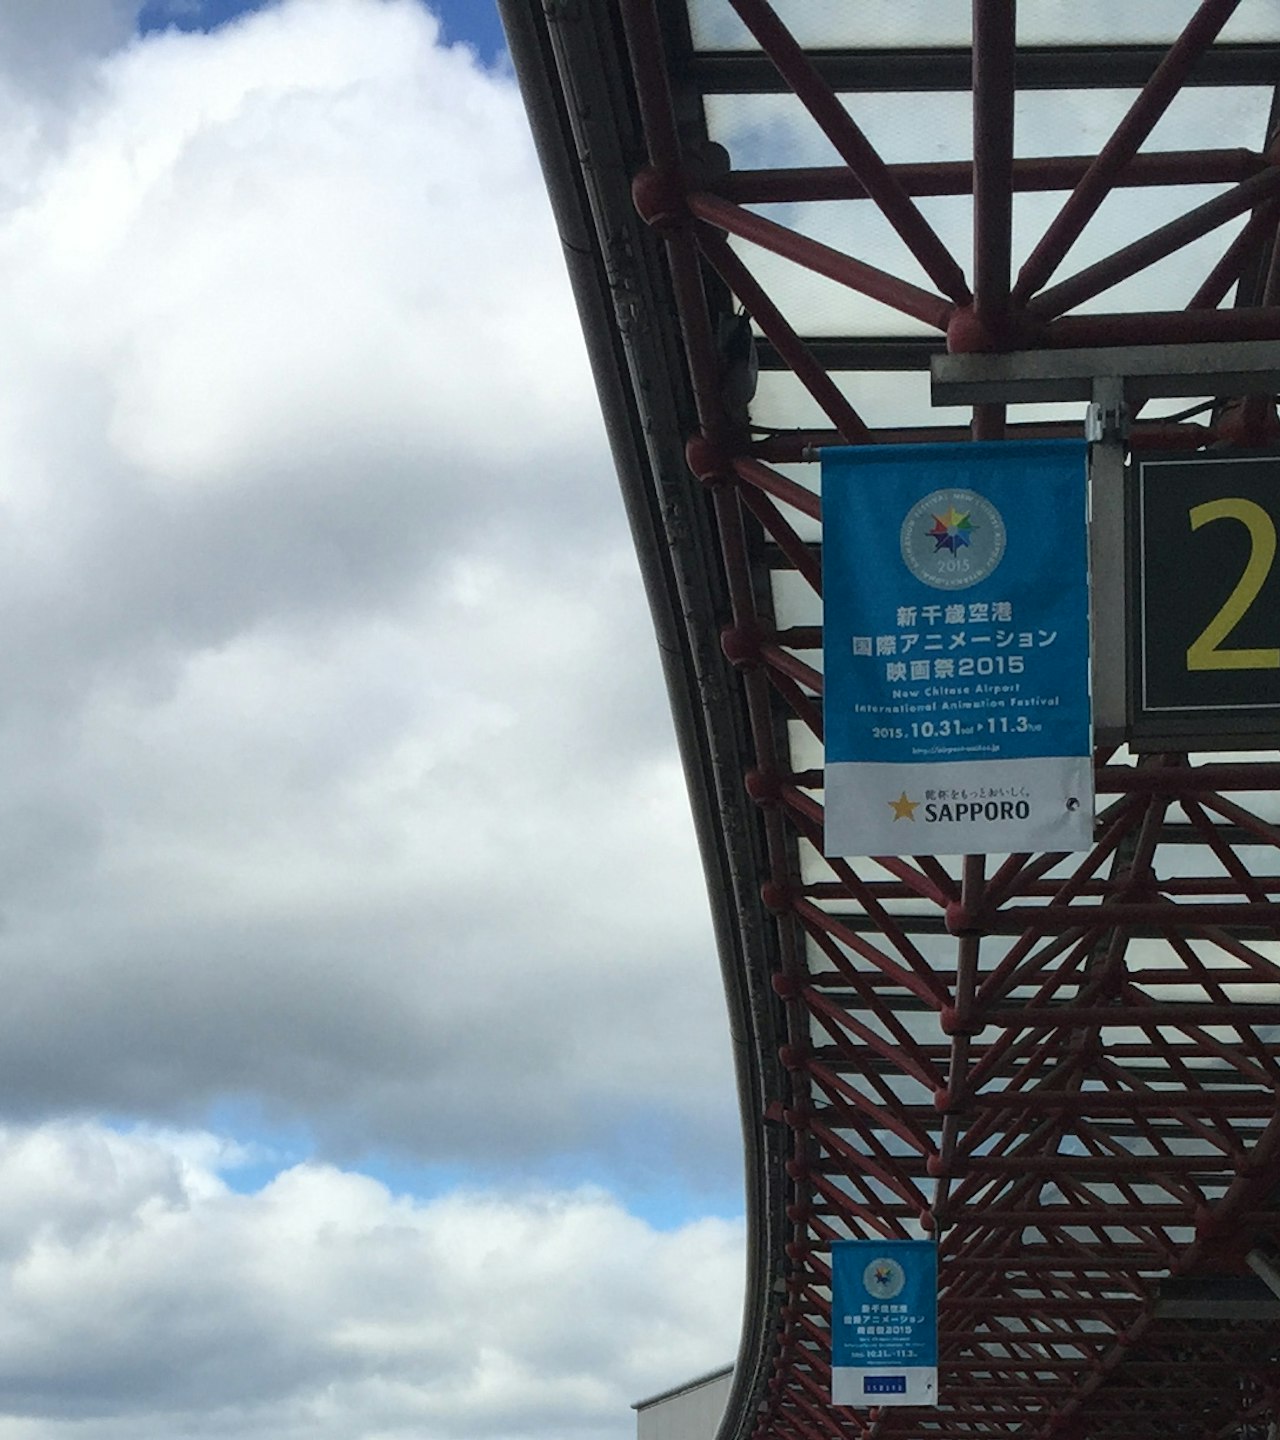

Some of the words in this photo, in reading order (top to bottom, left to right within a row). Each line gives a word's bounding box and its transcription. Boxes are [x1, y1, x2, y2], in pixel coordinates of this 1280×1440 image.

[937, 558, 971, 574] 2015
[896, 601, 1013, 627] 新千歳空港
[851, 630, 1058, 656] 国際アニメーション
[885, 654, 1026, 682] 映画祭2015
[892, 688, 919, 699] New
[975, 683, 1020, 696] Airport
[854, 702, 937, 714] International
[941, 698, 1005, 711] Animation
[1010, 696, 1059, 707] Festival
[925, 800, 1030, 823] SAPPORO
